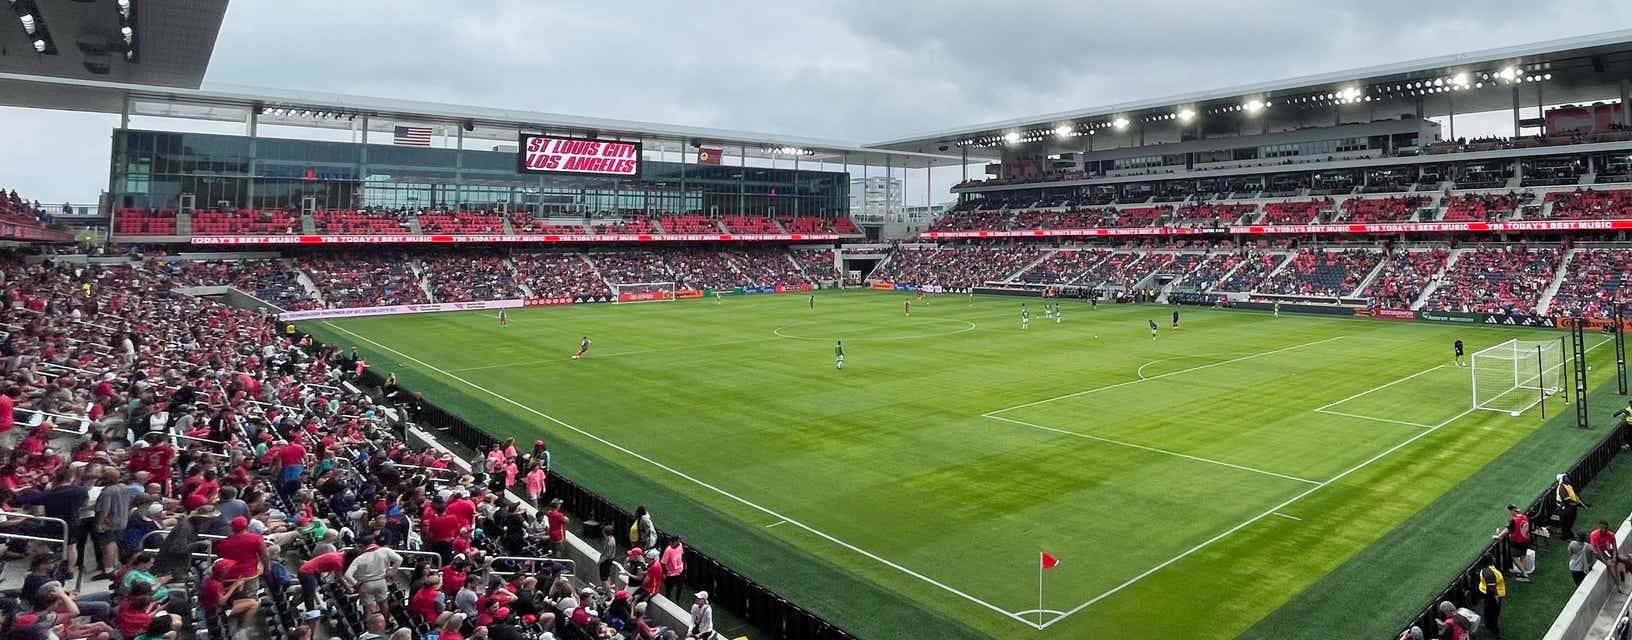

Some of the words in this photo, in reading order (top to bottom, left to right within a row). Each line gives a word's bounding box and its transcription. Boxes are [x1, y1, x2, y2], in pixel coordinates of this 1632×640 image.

[528, 138, 552, 152] ST
[552, 140, 601, 156] LOUIS
[602, 143, 636, 158] CITY
[526, 154, 562, 169] LOS
[562, 156, 636, 172] ANGELES
